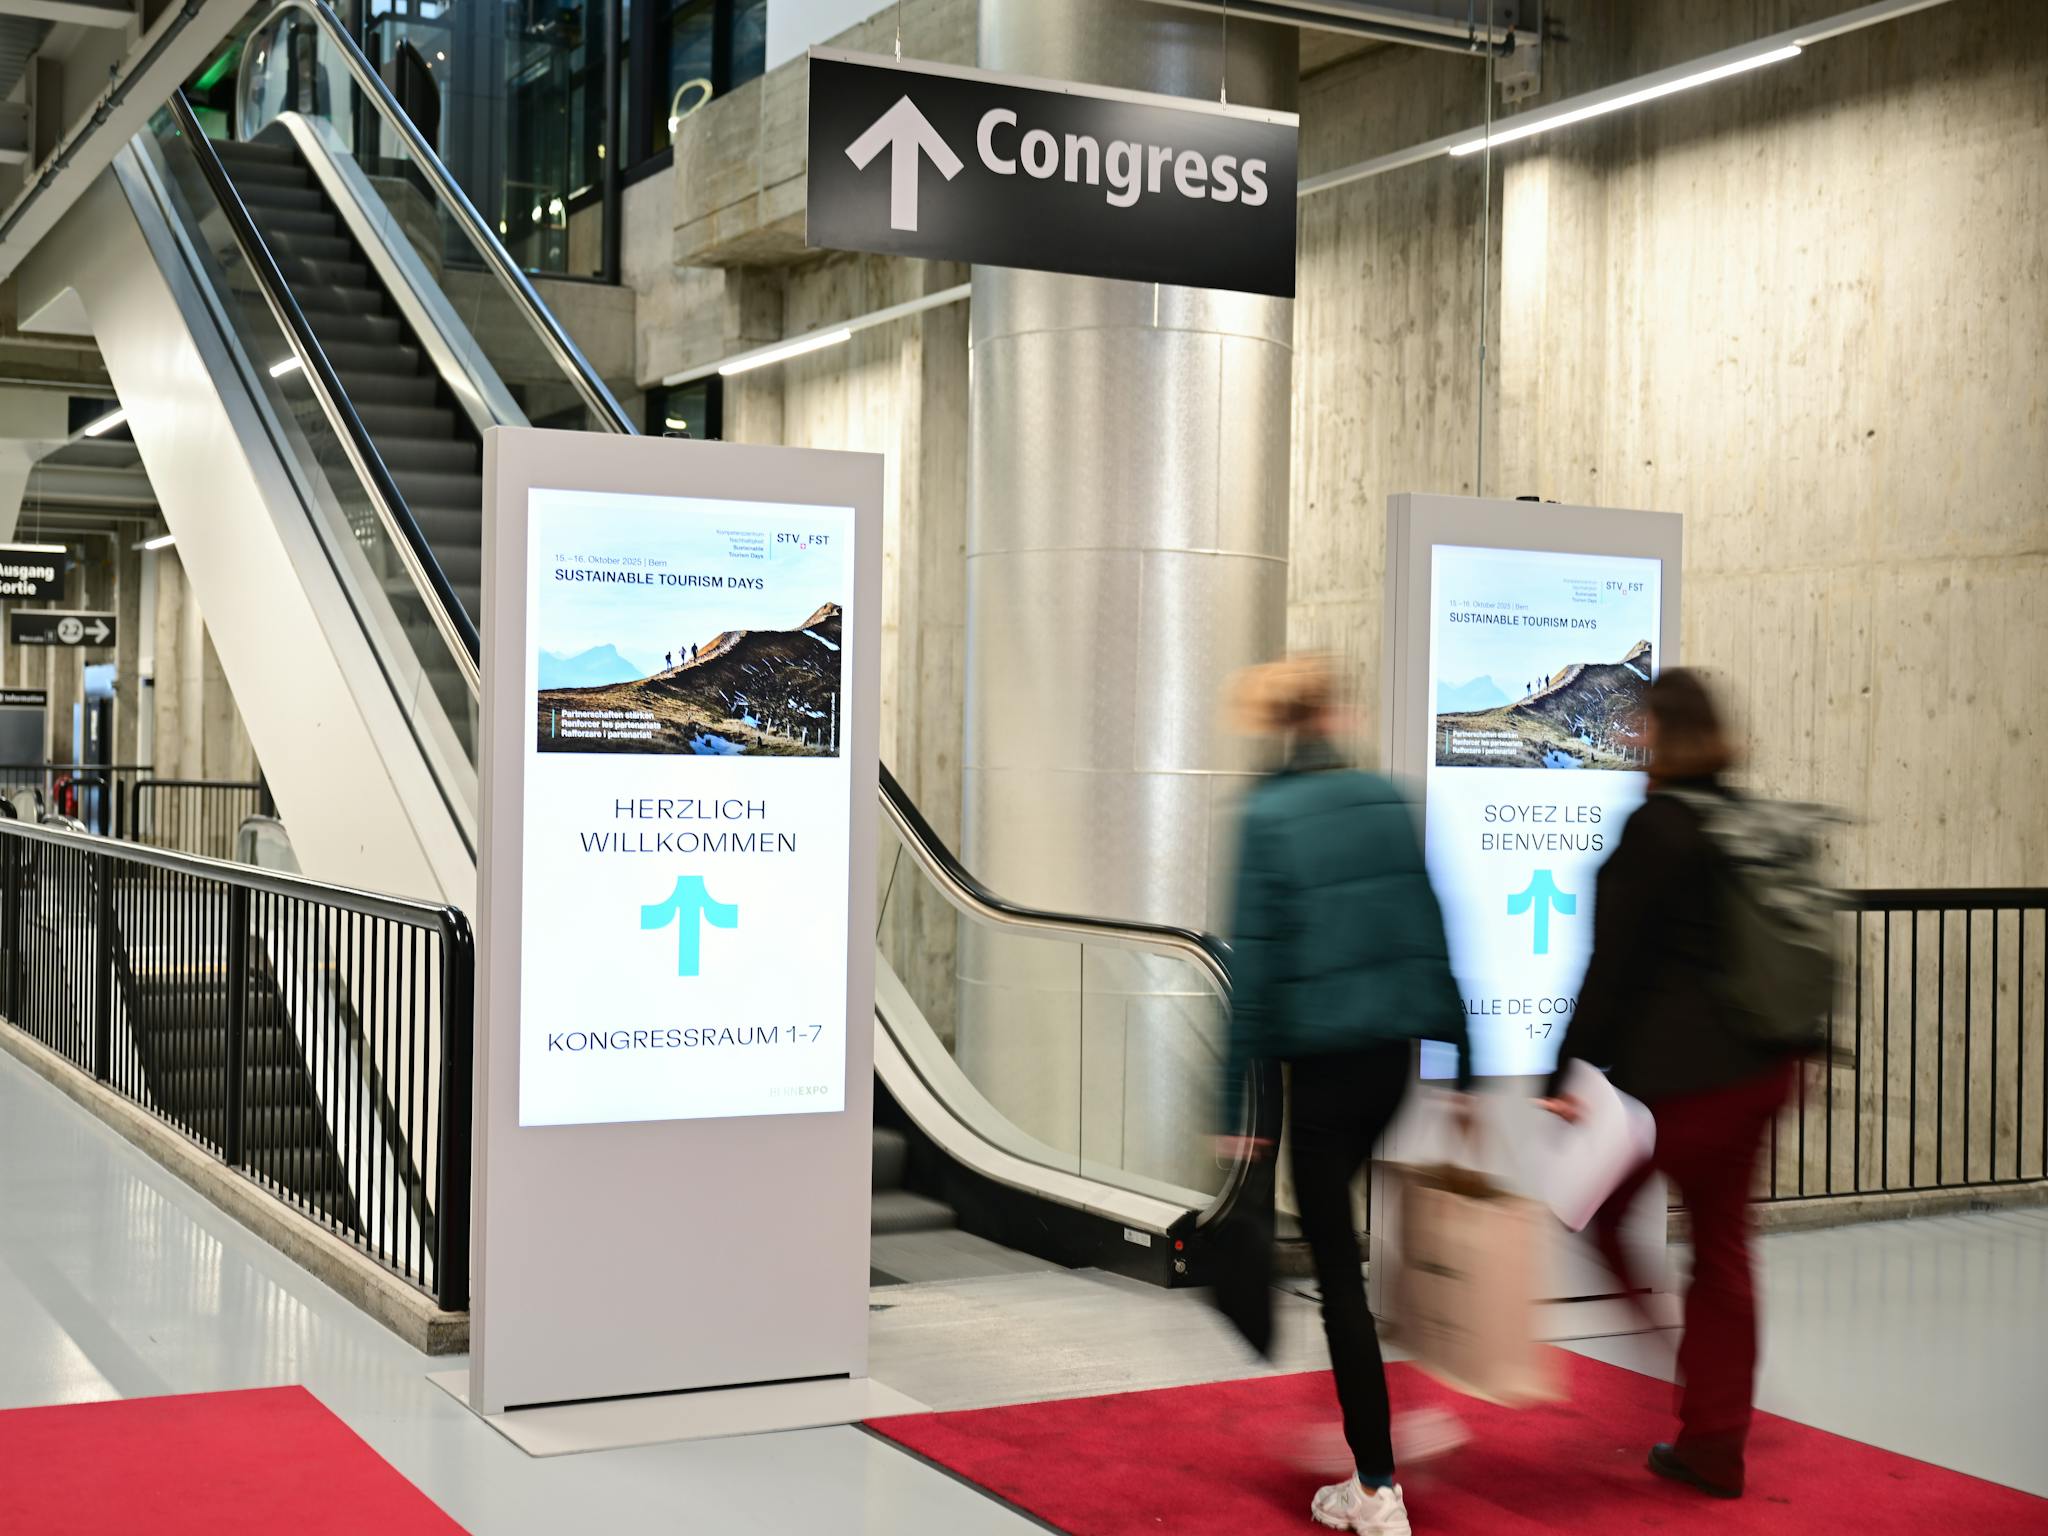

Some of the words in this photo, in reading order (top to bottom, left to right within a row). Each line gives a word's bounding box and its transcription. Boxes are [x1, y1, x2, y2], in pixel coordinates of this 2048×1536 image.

[976, 107, 1269, 208] Congress
[776, 532, 800, 543] STV
[808, 534, 830, 545] FST
[588, 555, 621, 566] Oktober
[622, 557, 642, 567] 2025
[648, 559, 668, 568] Bern
[0, 580, 37, 596] ortie
[555, 568, 654, 585] SUSTAINABLE
[659, 573, 724, 588] TOURISM
[727, 576, 764, 590] DAYS
[1606, 580, 1623, 590] STV
[1628, 582, 1644, 592] FST
[1449, 612, 1519, 626] SUSTAINABLE
[1522, 616, 1568, 628] TOURISM
[1571, 618, 1597, 630] DAYS
[561, 719, 600, 729] Renforcer
[560, 729, 602, 738] Rafforzare
[615, 798, 766, 820] HERZLICH
[1484, 804, 1557, 824] SOYEZ
[1565, 805, 1602, 824] LES
[580, 831, 797, 853] WILLKOMMEN
[1481, 833, 1604, 852] BIENVENUS
[1461, 998, 1502, 1015] ALLE
[1508, 998, 1532, 1015] DE
[548, 1025, 778, 1052] KONGRESSRAUM
[784, 1023, 823, 1044] 1-7
[1525, 1022, 1553, 1040] 1-7
